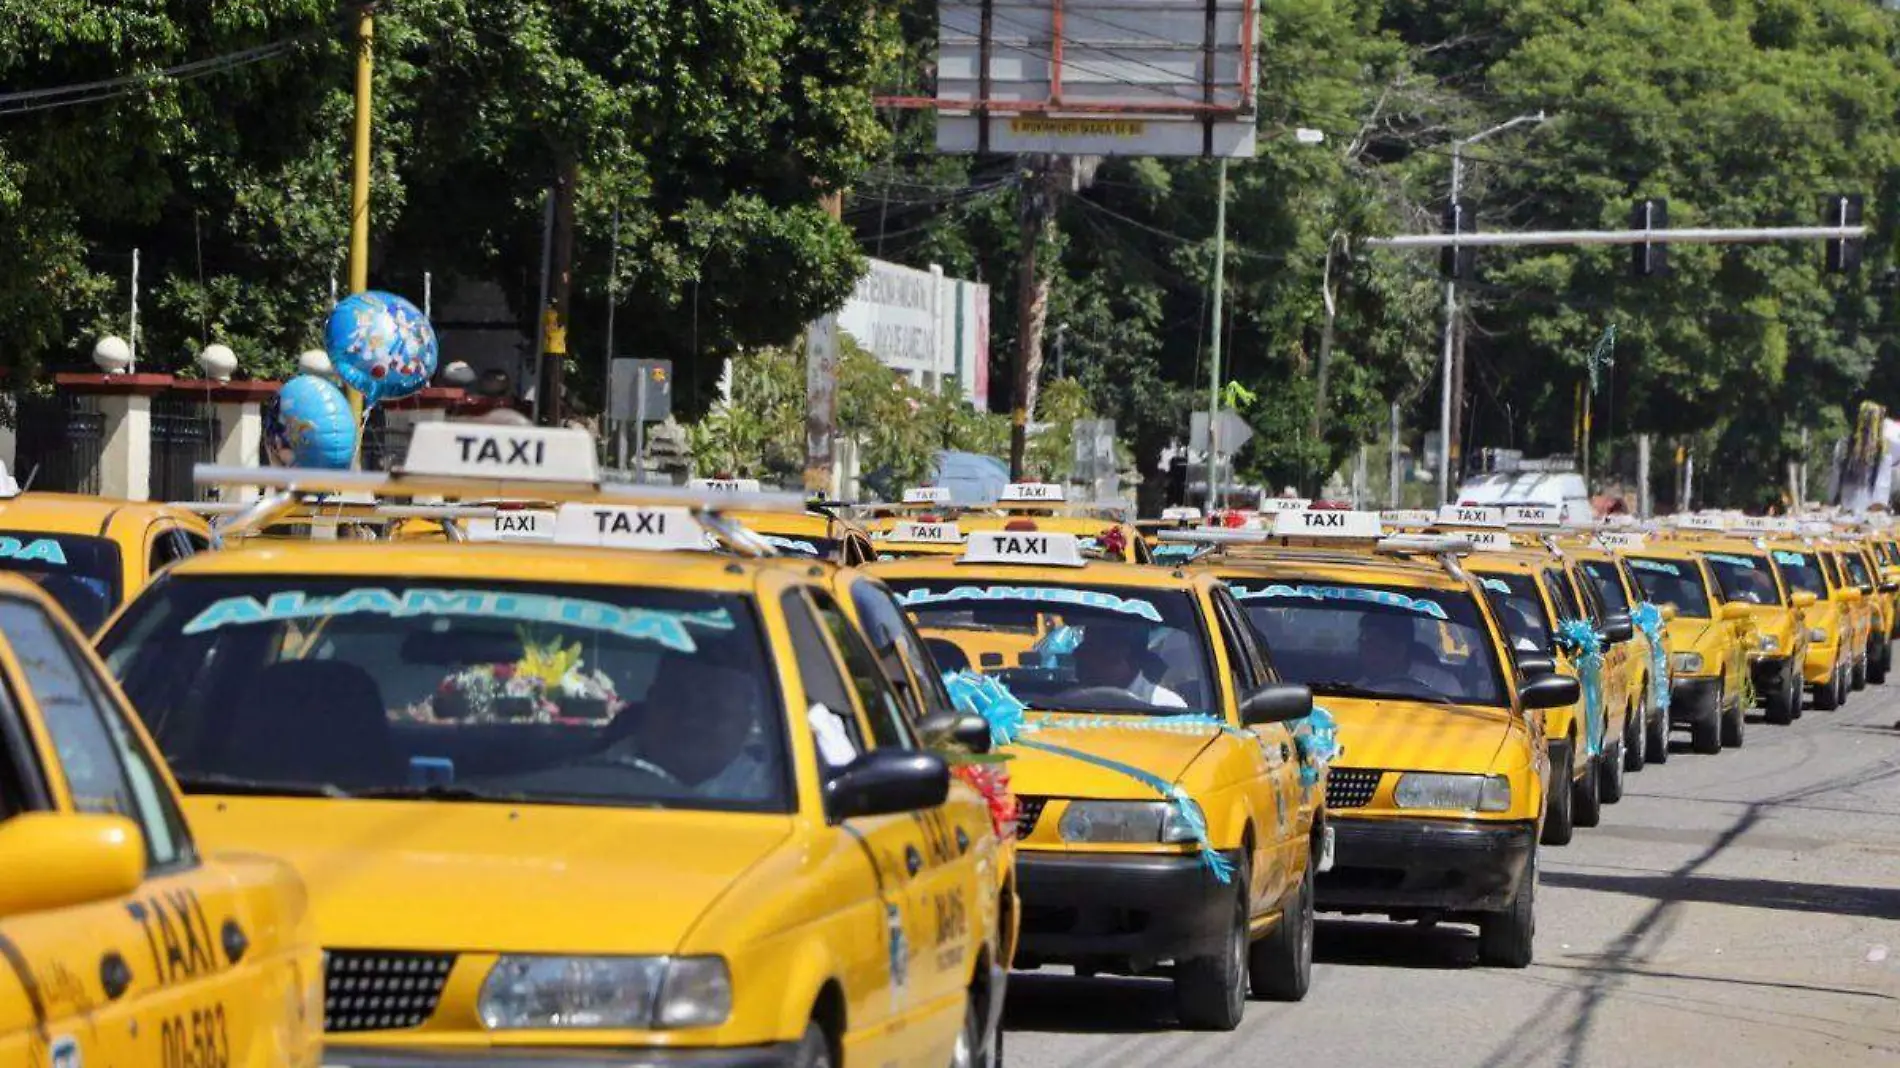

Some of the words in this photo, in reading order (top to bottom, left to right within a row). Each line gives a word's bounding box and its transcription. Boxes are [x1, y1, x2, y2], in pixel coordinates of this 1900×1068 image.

[456, 435, 545, 466] TAXI
[1017, 486, 1047, 497] TAXI
[1302, 513, 1345, 527] TAXI
[1456, 510, 1487, 522] TAXI
[1518, 508, 1545, 519] TAXI
[494, 514, 535, 532] TAXI
[594, 510, 666, 535] TAXI
[910, 525, 942, 539] TAXI
[993, 537, 1048, 555] TAXI
[1466, 534, 1495, 545] TAXI
[122, 886, 219, 987] TAXI
